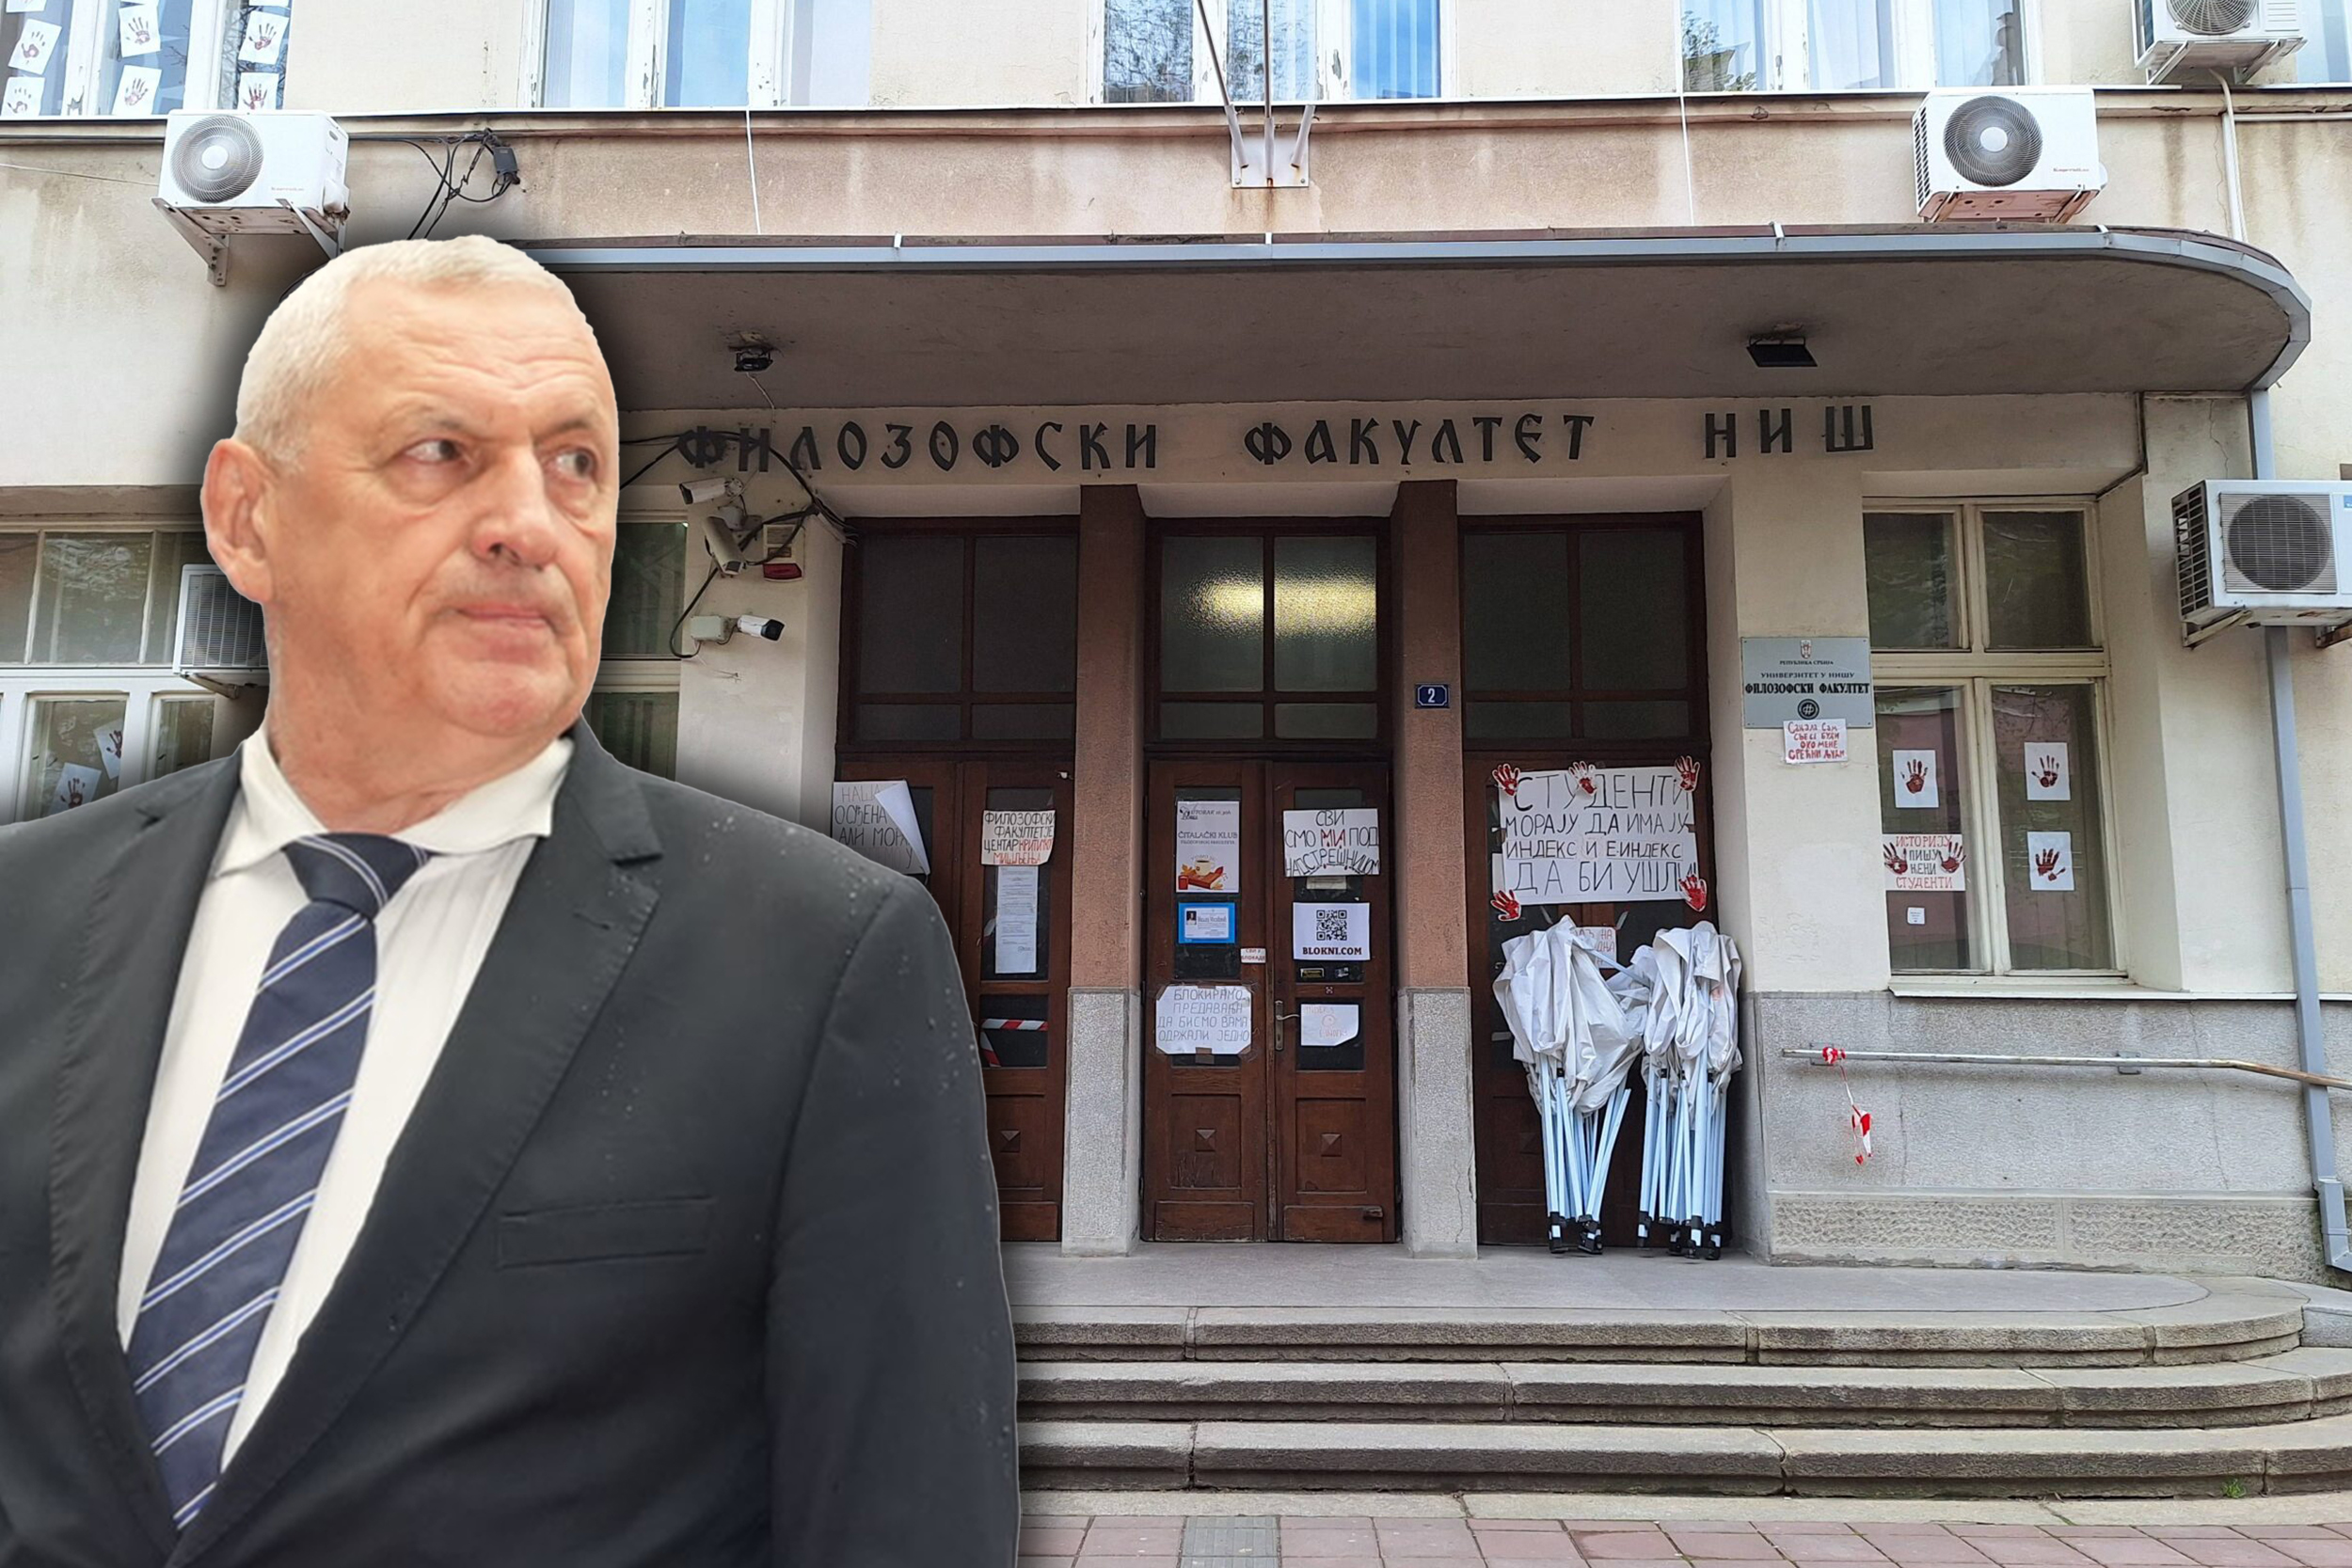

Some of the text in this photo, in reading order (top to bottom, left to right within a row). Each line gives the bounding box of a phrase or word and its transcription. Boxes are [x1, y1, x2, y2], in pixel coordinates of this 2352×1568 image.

[678, 405, 1873, 472] ФИЛОЗОФСКИ ФАКУЛТЕТ НИШ
[1745, 683, 1870, 694] ФИЛОЗОФСКИ ФАКУЛТЕТ
[1427, 688, 1436, 703] 2
[1515, 773, 1690, 811] СТУДЕНТИ
[1315, 810, 1344, 826] СВИ
[1505, 813, 1689, 837] МОРАЈУ ДА ИМАЈУ
[994, 826, 1043, 838] ФАКУЛТЕТ
[1285, 827, 1379, 848] СМО МИ ПОД
[984, 839, 1018, 853] ЦЕНТАР
[1896, 835, 1953, 847] ИСТОРИЈУ
[1506, 840, 1577, 859] ИНДЕКС
[1585, 841, 1597, 858] И
[1909, 849, 1939, 861] ПИШУ
[1513, 861, 1697, 895] ДА БИ УШЛИ
[1896, 877, 1953, 889] СТУДЕНТИ
[1302, 946, 1362, 956] BLOKNI.COM
[1173, 988, 1243, 1001] БЛОКИРАМО
[1157, 1016, 1248, 1028] ДА БИСМО ВАМА
[1158, 1029, 1249, 1042] ОДРЖАЛИ ЈЕДНО
